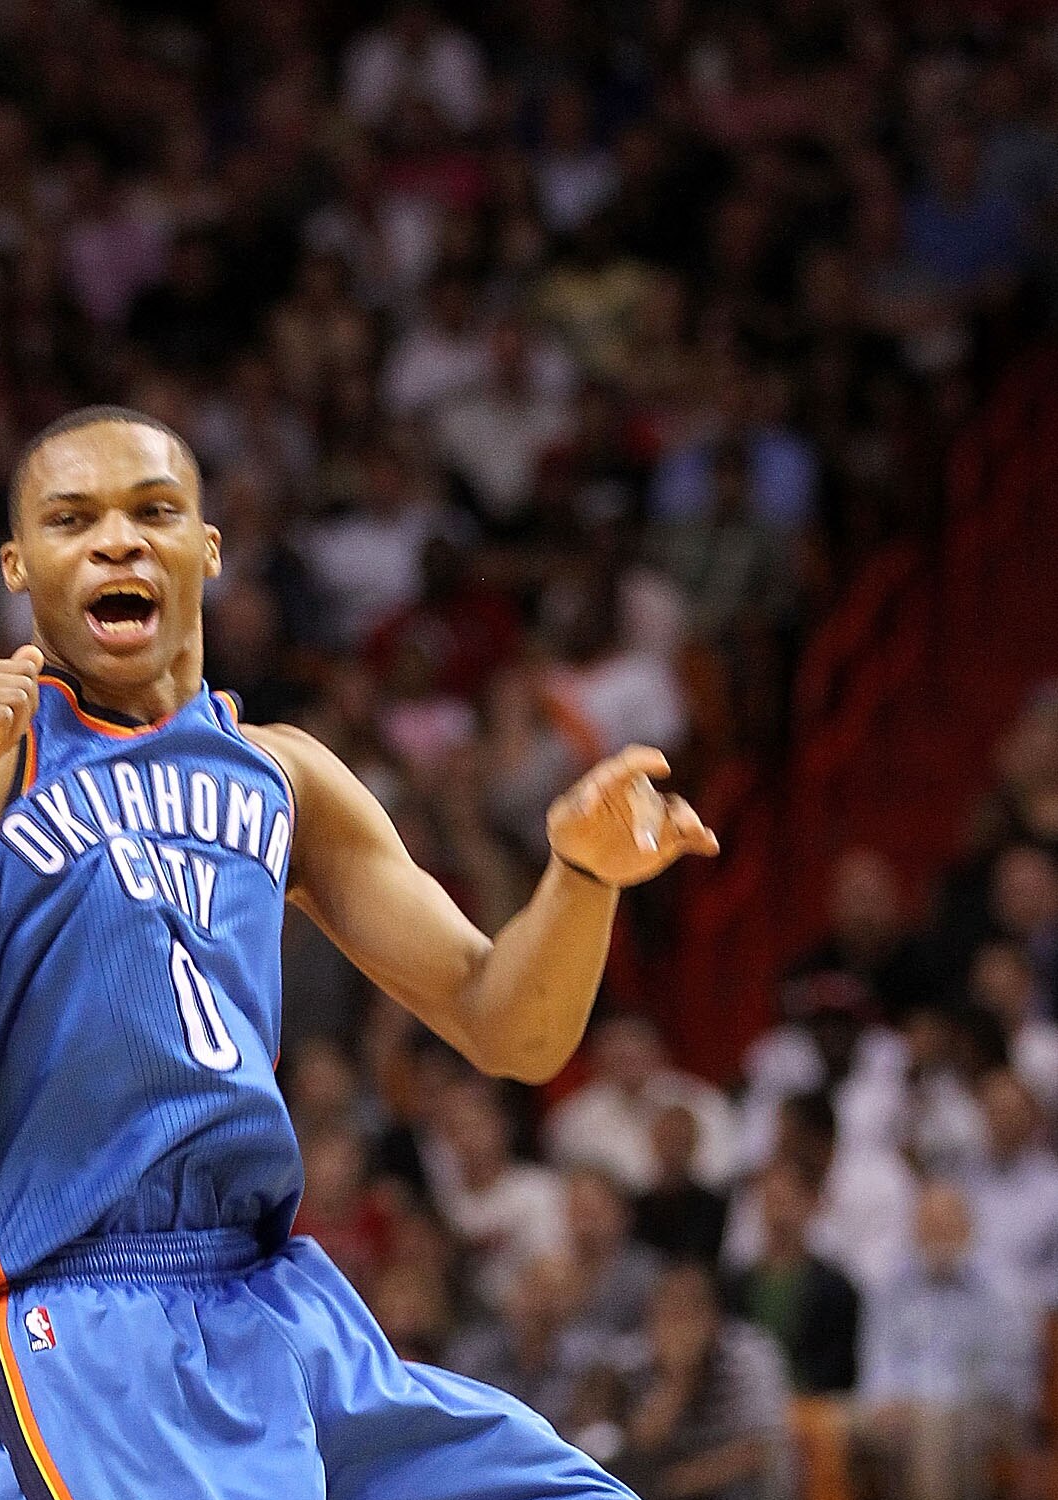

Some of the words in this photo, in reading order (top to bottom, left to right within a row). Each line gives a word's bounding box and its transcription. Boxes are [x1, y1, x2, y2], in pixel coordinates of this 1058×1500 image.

[1, 760, 291, 884] OKLAHOMA
[108, 835, 218, 930] CITY
[171, 938, 242, 1072] 0
